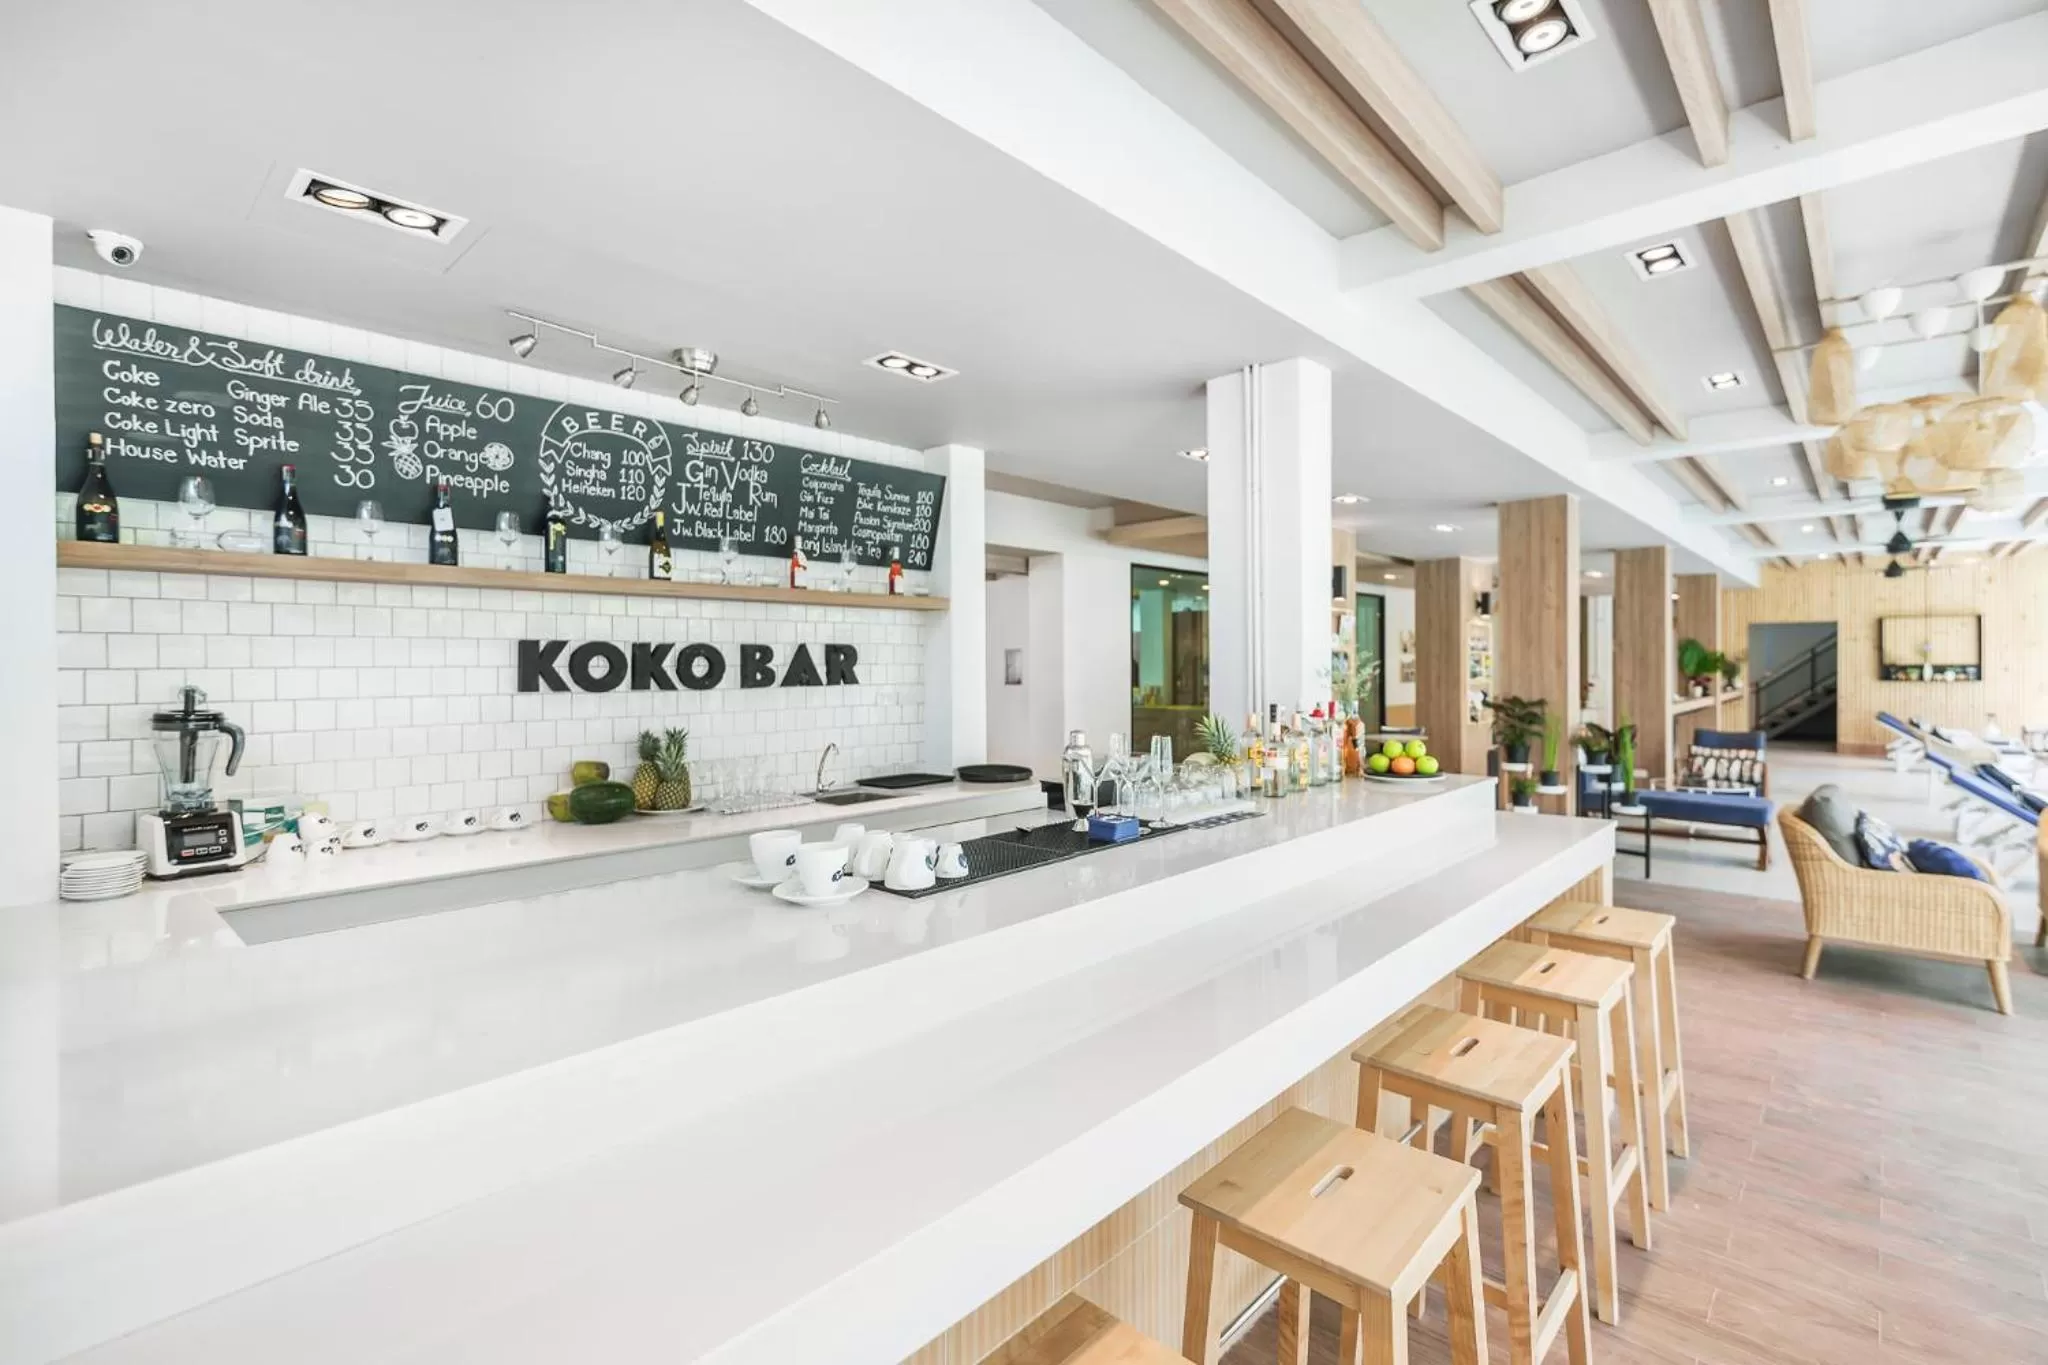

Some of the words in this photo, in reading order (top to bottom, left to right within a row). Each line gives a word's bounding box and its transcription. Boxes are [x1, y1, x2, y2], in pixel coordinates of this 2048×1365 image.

[103, 360, 160, 386] Coke
[103, 387, 159, 410] Coke
[165, 399, 216, 418] zero
[227, 380, 290, 412] Ginger
[298, 392, 331, 414] Ale
[334, 397, 375, 422] 35
[398, 384, 467, 414] Juice
[476, 393, 515, 422] 60
[104, 412, 158, 434] Coke
[164, 418, 219, 449] Light
[233, 405, 284, 429] Soda
[426, 415, 478, 442] Apple
[561, 411, 648, 438] BEER
[234, 427, 300, 457] Sprite
[570, 442, 611, 469] Chang
[621, 449, 646, 466] 100
[741, 440, 775, 463] 130
[106, 437, 178, 463] House
[185, 448, 248, 470] Water
[334, 464, 375, 489] 30
[423, 440, 490, 473] Orange
[425, 464, 510, 499] Pineapple
[565, 460, 607, 485] Singha
[619, 467, 646, 485] 110
[685, 460, 718, 484] Gin
[720, 460, 768, 490] Vodka
[561, 478, 616, 499] Heineken
[619, 485, 646, 501] 120
[749, 480, 778, 508] Rum
[703, 501, 724, 518] Red
[726, 504, 757, 522] Label
[695, 520, 723, 538] Black
[726, 521, 756, 542] Label
[764, 525, 787, 544] 180
[517, 639, 726, 693] KOKO
[740, 642, 860, 689] BAR
